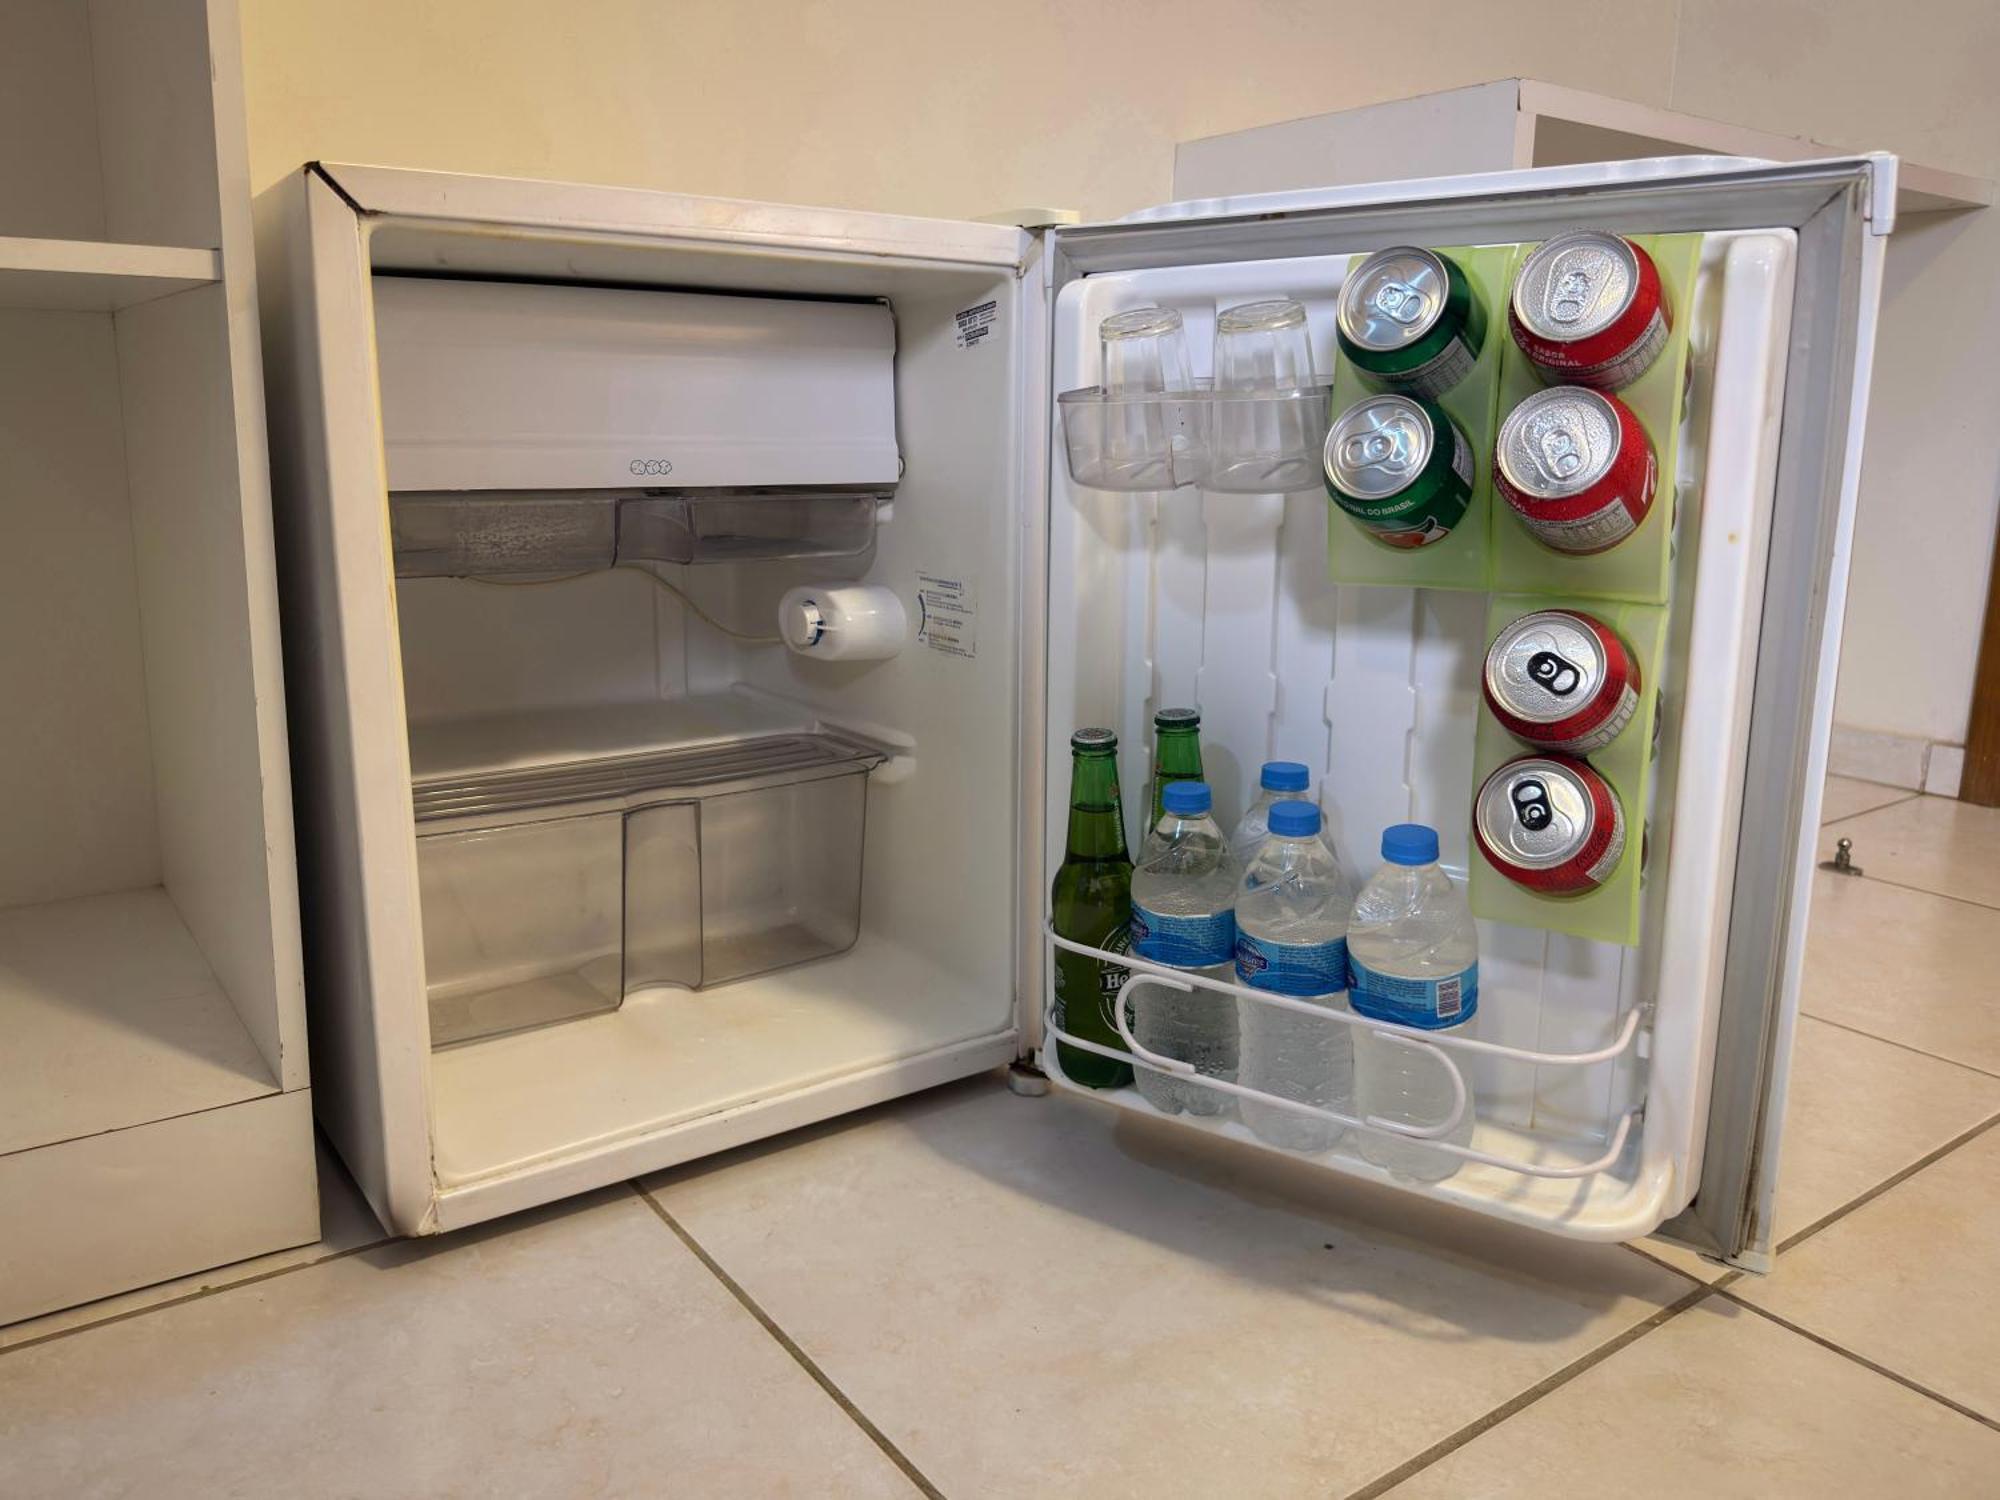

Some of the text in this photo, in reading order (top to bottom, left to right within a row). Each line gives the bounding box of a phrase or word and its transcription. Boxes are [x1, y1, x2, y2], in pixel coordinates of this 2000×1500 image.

[1533, 343, 1566, 359] SABOR
[1531, 352, 1582, 367] ORIGINAL
[1367, 508, 1381, 516] DO
[1382, 499, 1416, 515] BRASIL
